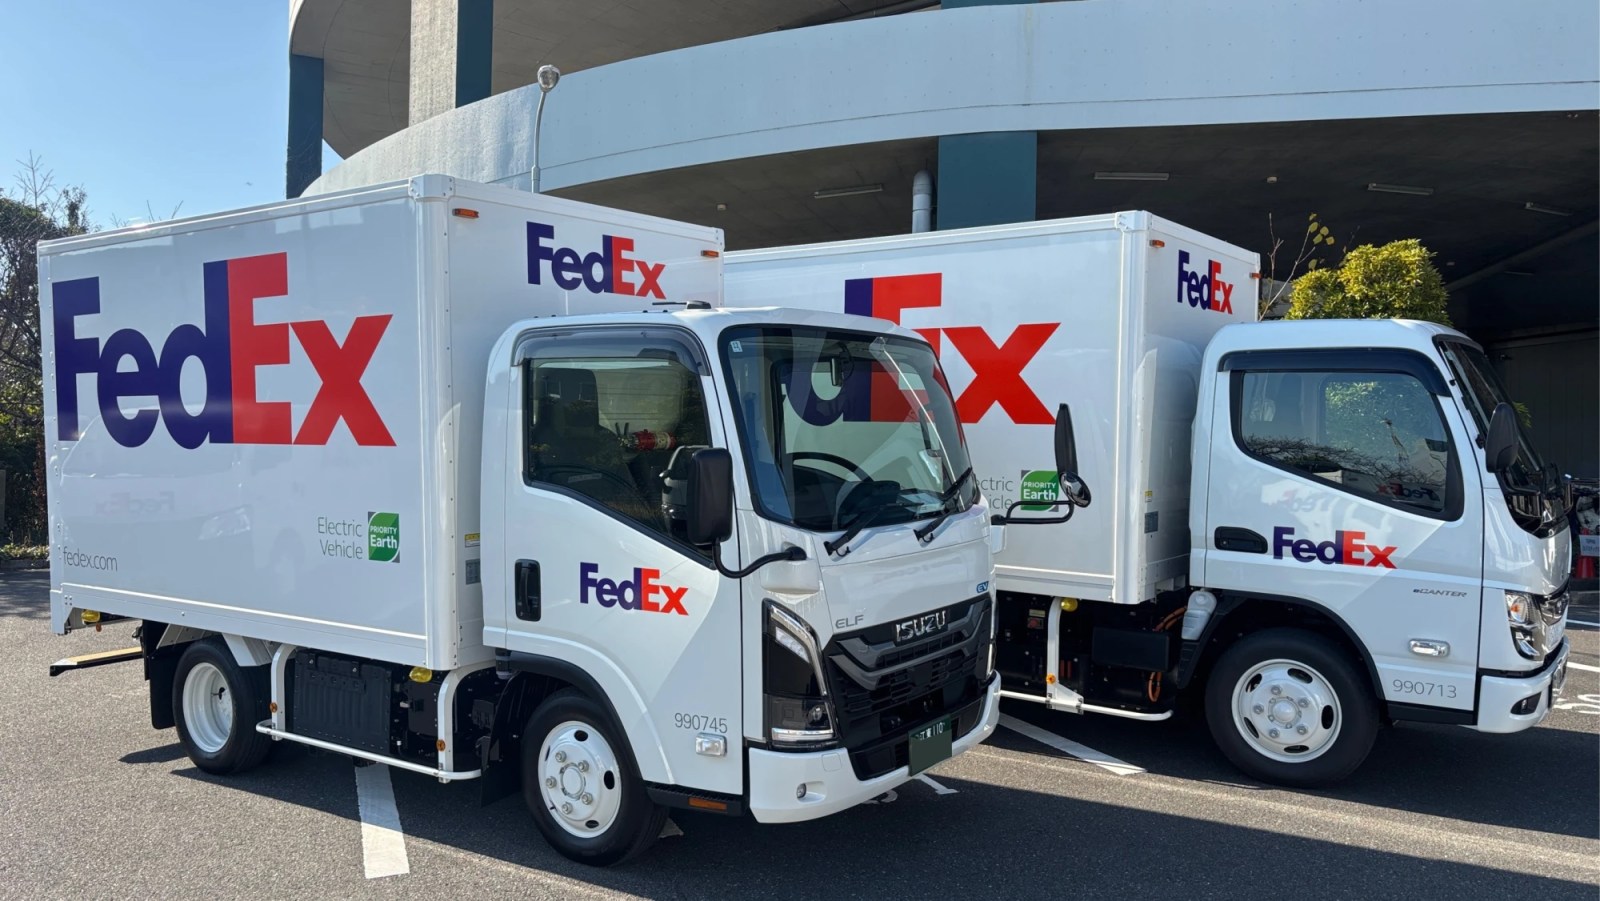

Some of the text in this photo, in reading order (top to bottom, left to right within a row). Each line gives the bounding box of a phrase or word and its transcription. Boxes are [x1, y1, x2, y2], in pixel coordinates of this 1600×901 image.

[526, 221, 667, 300] FedEx
[1177, 249, 1234, 315] FedEx
[51, 251, 397, 450] FedEx
[781, 272, 1061, 426] dEx
[976, 476, 1014, 492] ctric
[1023, 481, 1057, 489] PRIORITY
[988, 494, 1013, 510] icle
[1023, 489, 1056, 501] Earth
[317, 516, 363, 537] Electric
[369, 526, 397, 535] PRIORITY
[319, 539, 363, 560] Vehicle
[370, 534, 398, 549] Earth
[1273, 525, 1398, 569] FedEx
[62, 546, 118, 572] fedex.com
[579, 561, 689, 616] FedEx
[977, 579, 988, 592] EV
[1413, 588, 1468, 598] eCANTER
[834, 614, 865, 629] ELF
[895, 610, 947, 642] ISUZU
[1392, 679, 1457, 699] 990713
[674, 712, 728, 734] 990745
